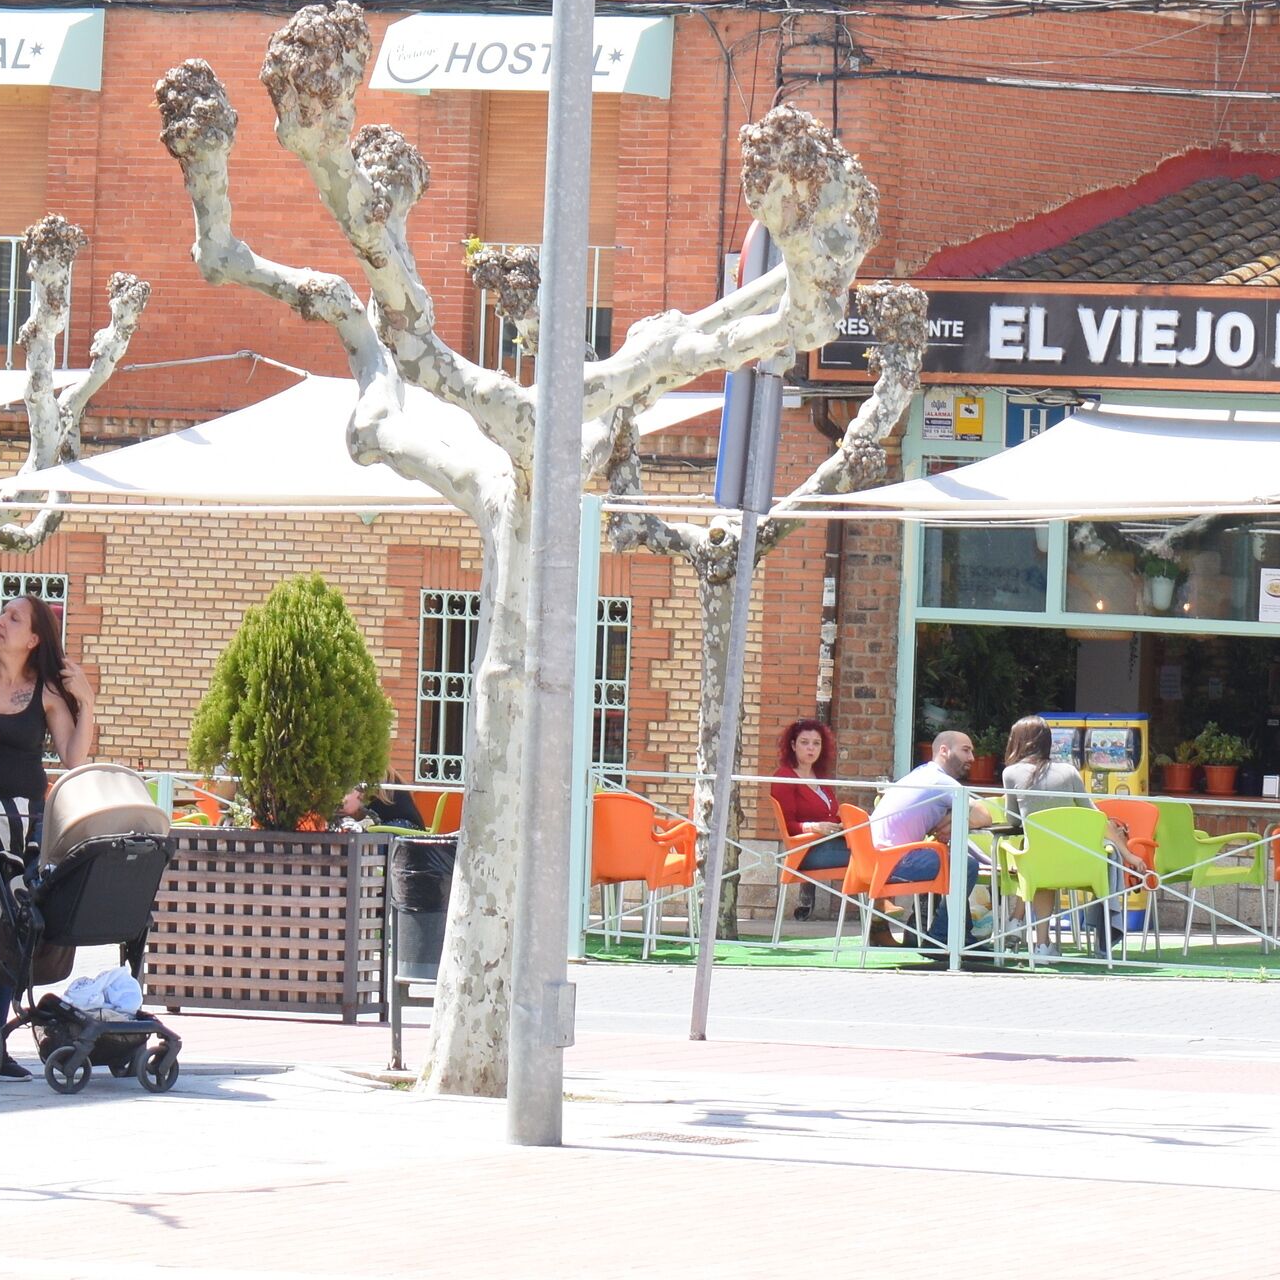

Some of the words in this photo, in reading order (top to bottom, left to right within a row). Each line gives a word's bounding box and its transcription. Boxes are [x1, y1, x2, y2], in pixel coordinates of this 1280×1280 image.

[444, 42, 611, 76] HOSTL
[988, 305, 1064, 362] EL
[1077, 307, 1256, 368] VIEJO
